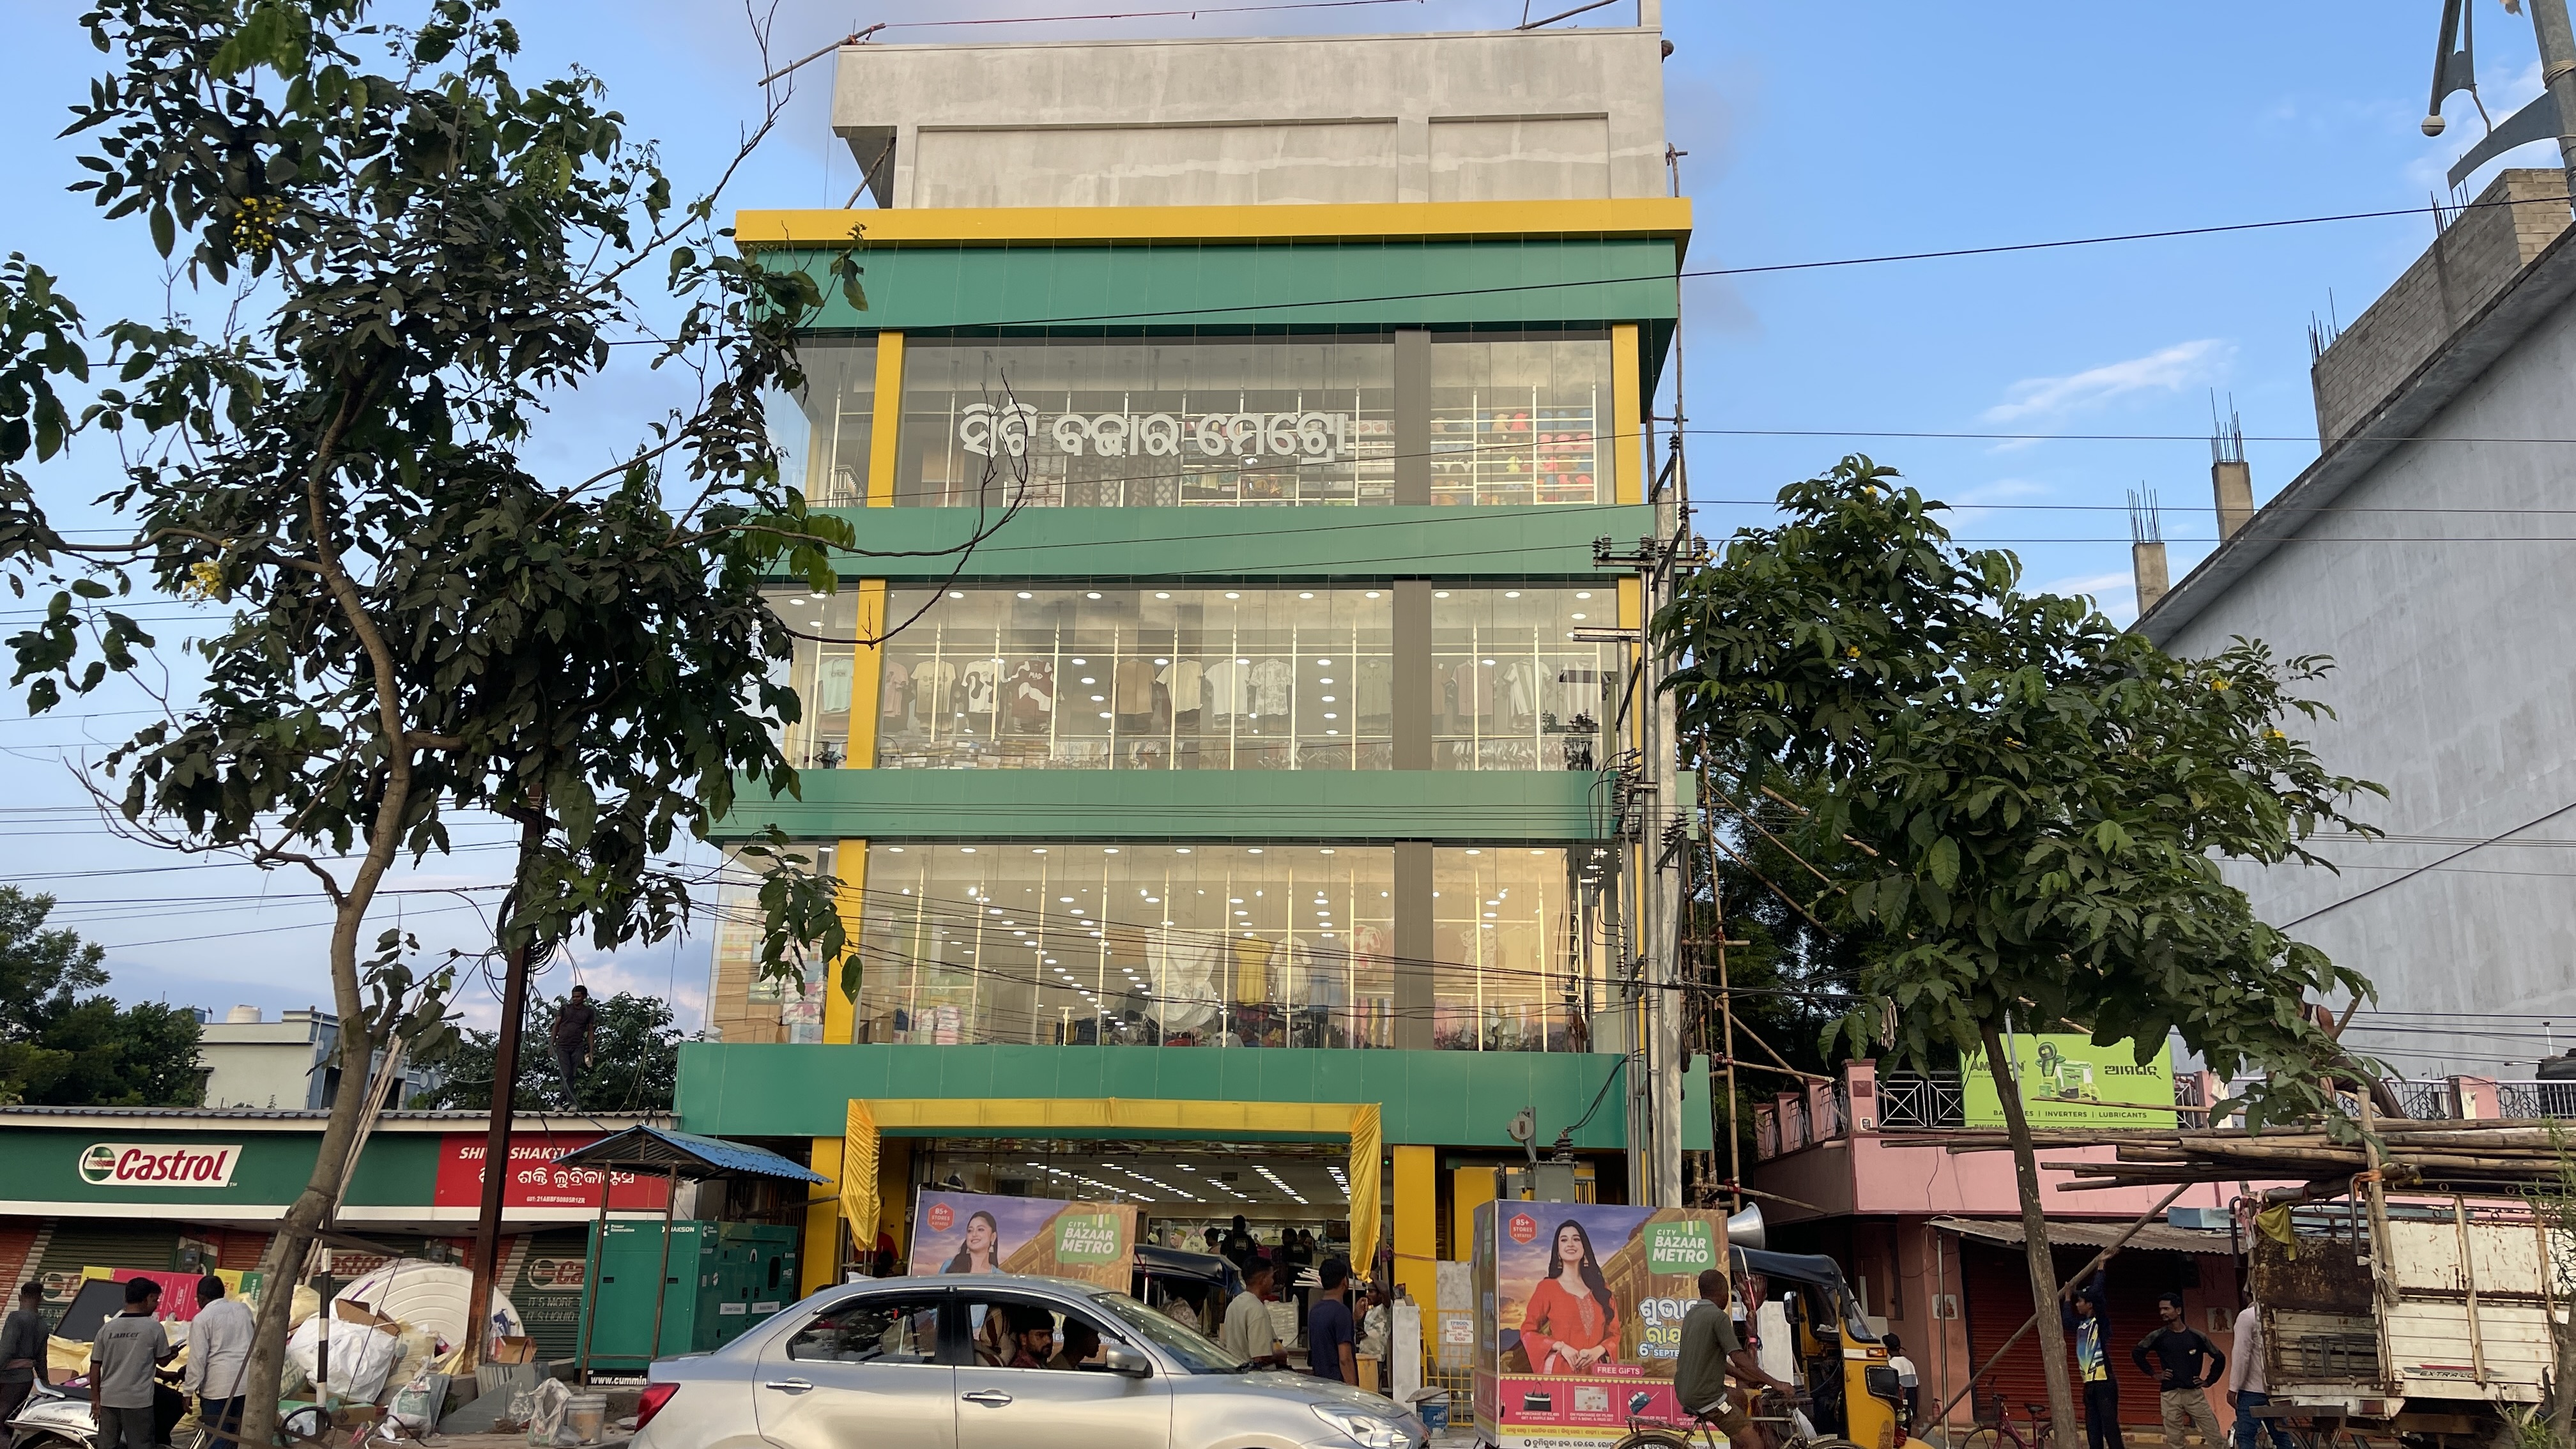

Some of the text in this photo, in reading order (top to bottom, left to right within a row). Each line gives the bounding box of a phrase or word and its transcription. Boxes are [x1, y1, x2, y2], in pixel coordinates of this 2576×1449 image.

[116, 1149, 229, 1181] Castrol
[1064, 1227, 1114, 1241] BAZAAR
[1061, 1239, 1114, 1254] METRO
[1655, 1236, 1706, 1248] BAZAAR
[1652, 1248, 1709, 1263] METRO
[590, 1375, 648, 1386] www.cummin
